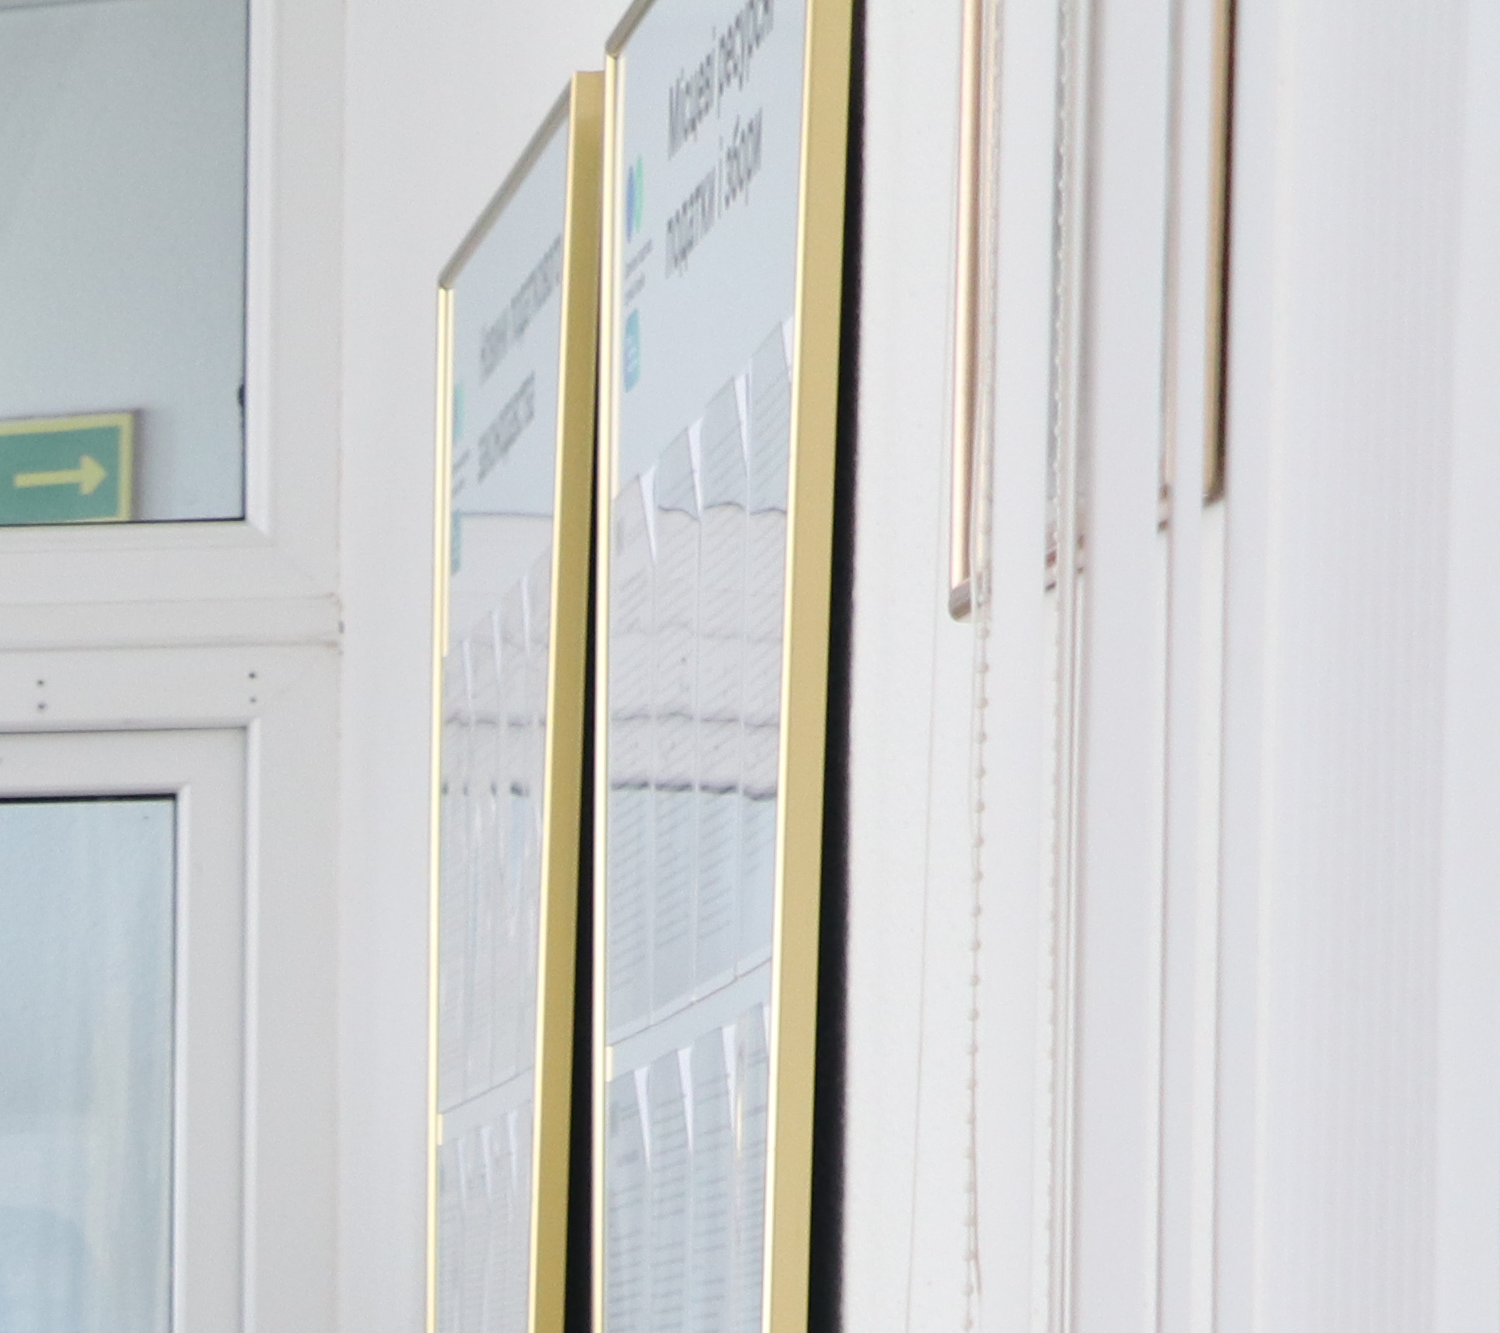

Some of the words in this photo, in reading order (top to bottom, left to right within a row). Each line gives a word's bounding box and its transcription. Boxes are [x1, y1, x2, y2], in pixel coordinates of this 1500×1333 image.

[667, 25, 716, 162] Місцеві
[665, 164, 717, 280] податки
[724, 107, 764, 212] збори
